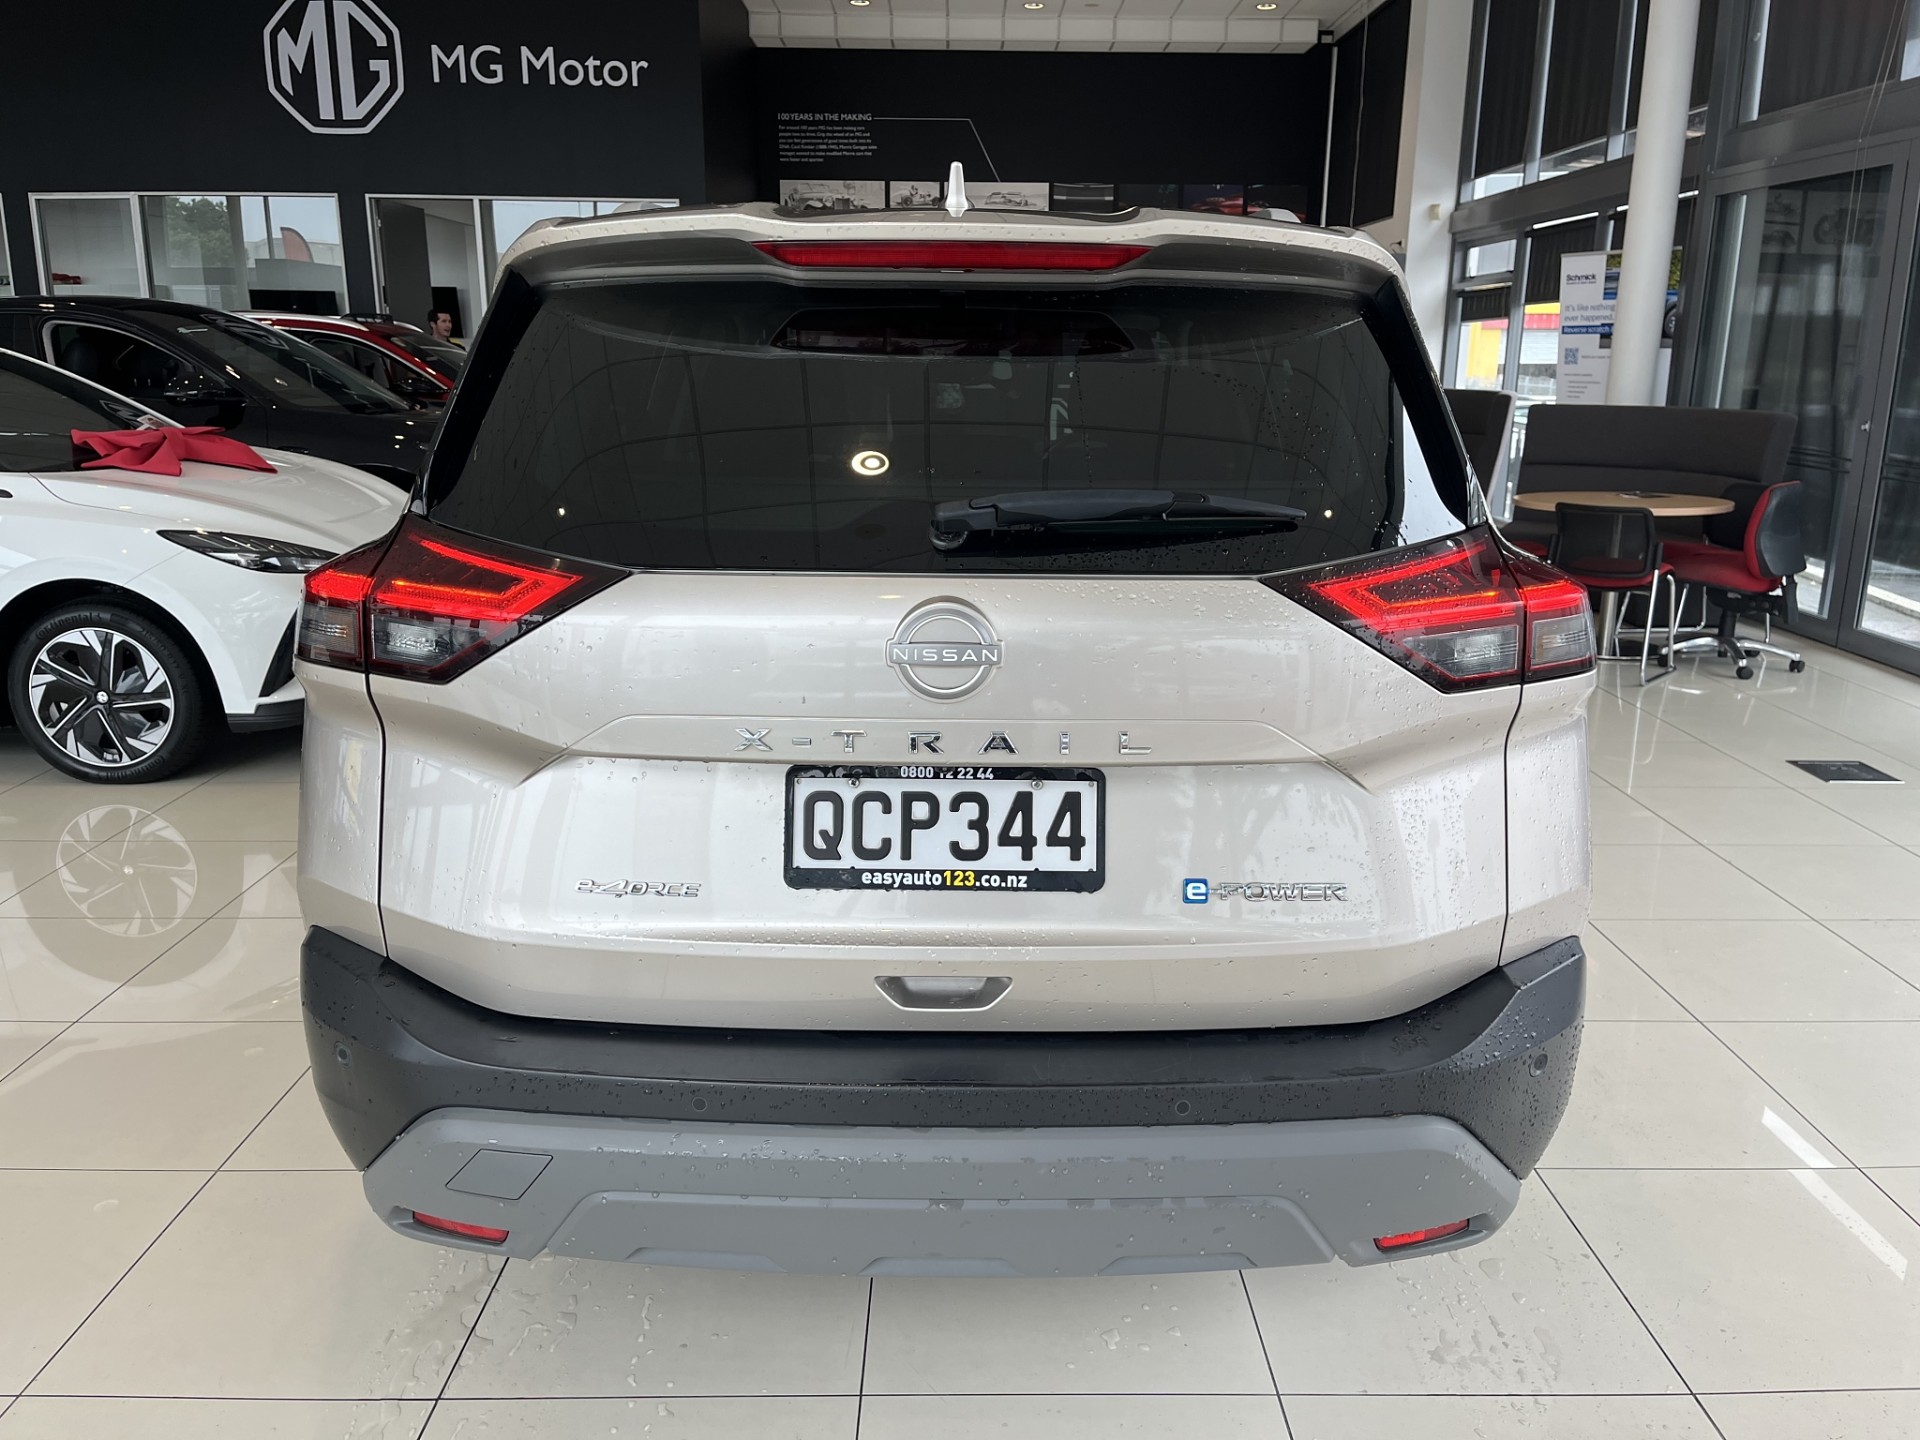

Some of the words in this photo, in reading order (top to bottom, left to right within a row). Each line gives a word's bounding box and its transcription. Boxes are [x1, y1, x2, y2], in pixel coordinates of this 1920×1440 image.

[277, 0, 391, 121] MG
[430, 44, 504, 85] MG
[520, 46, 649, 87] Motor
[777, 113, 789, 121] 100
[790, 113, 813, 121] YEARS
[814, 113, 824, 121] IN
[824, 113, 839, 121] THE
[841, 113, 873, 121] MAKING
[1566, 273, 1597, 282] Schmick
[1565, 304, 1576, 312] It's
[1577, 304, 1590, 312] like
[1590, 303, 1616, 313] nothing
[1564, 315, 1579, 323] ever
[1580, 313, 1614, 323] happened.
[1564, 326, 1587, 334] Reverse
[1587, 325, 1610, 334] scratch
[892, 647, 998, 663] NISSAN
[733, 727, 1153, 756] X-TRAIL
[900, 765, 934, 778] 0800
[957, 767, 974, 779] 22
[976, 768, 994, 780] 44
[803, 790, 1087, 862] QCP344
[861, 870, 1028, 889] easyauto123.co.nz
[1185, 880, 1349, 902] e-POWER
